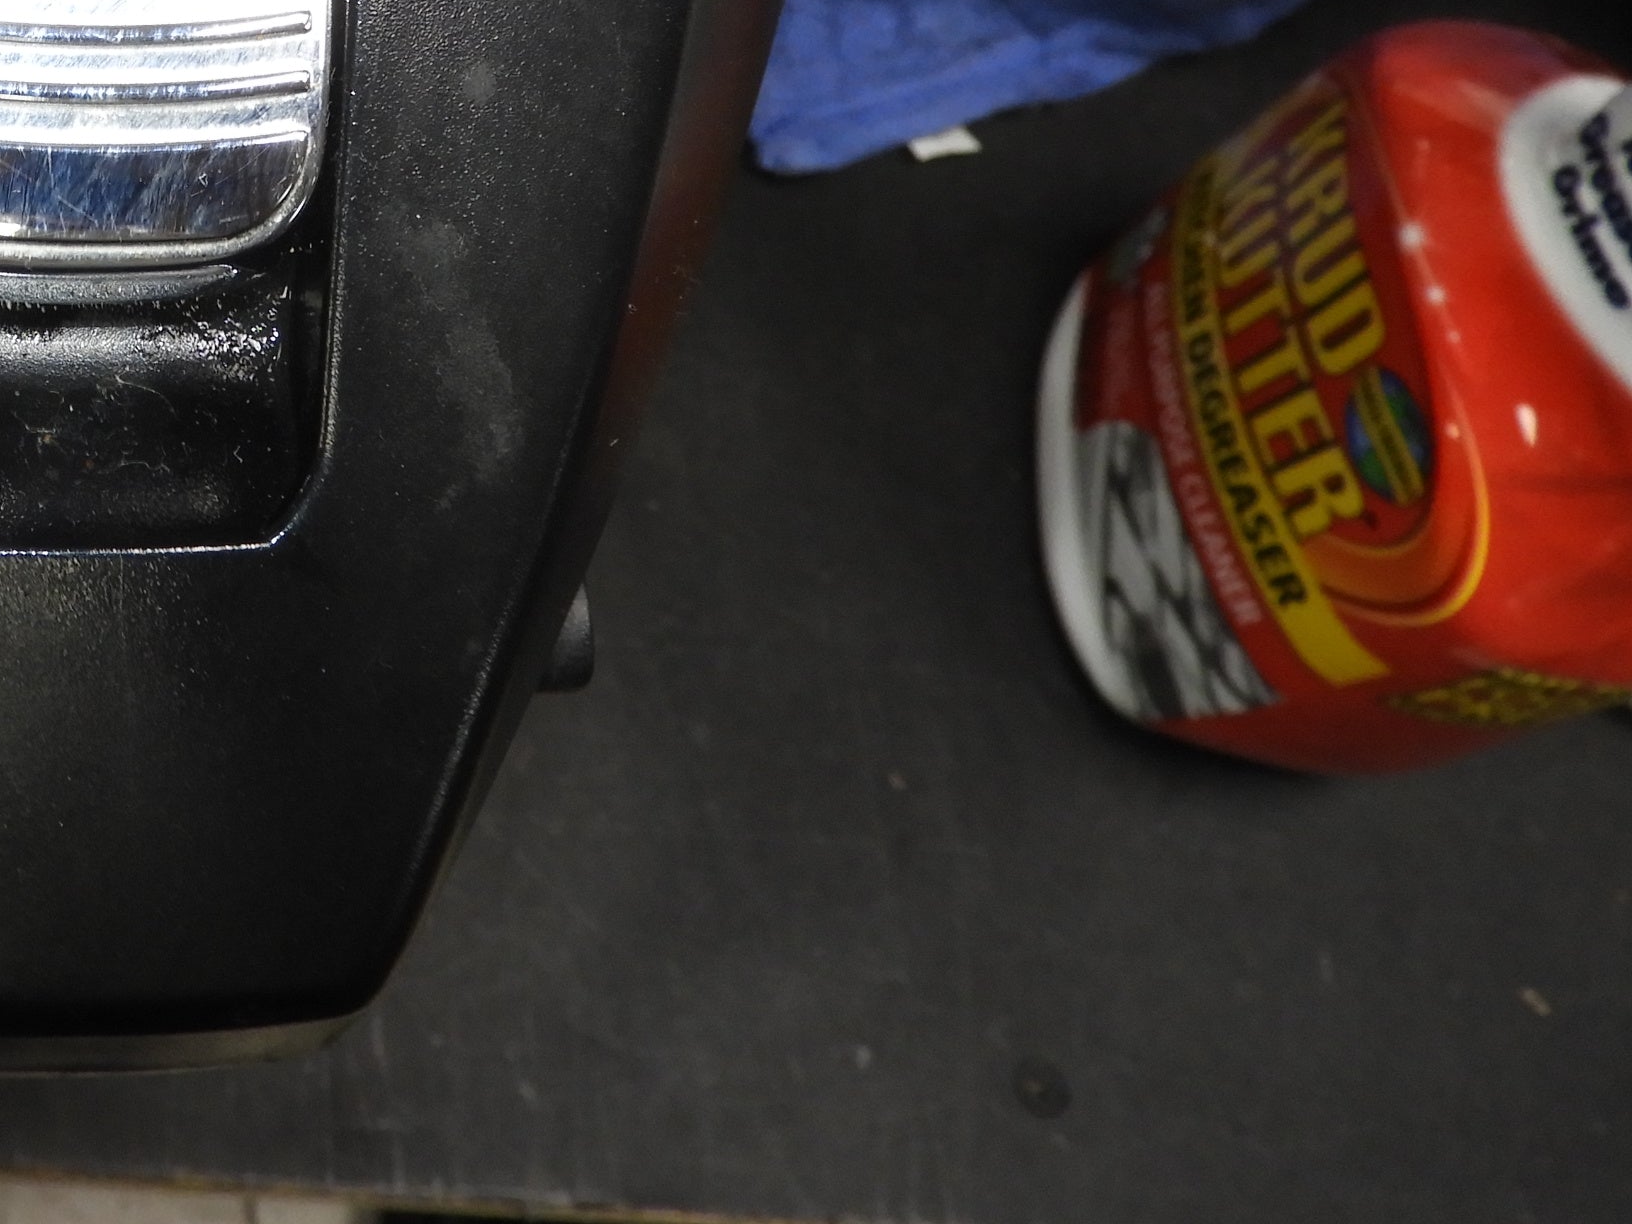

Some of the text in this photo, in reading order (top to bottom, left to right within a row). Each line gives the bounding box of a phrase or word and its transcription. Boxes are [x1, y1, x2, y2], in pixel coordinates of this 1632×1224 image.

[1218, 156, 1364, 539] KUTTER
[1285, 98, 1385, 375] KRUD
[1553, 164, 1631, 311] Grime
[1177, 472, 1263, 623] CLEANER
[1186, 331, 1308, 607] DEGREASER
